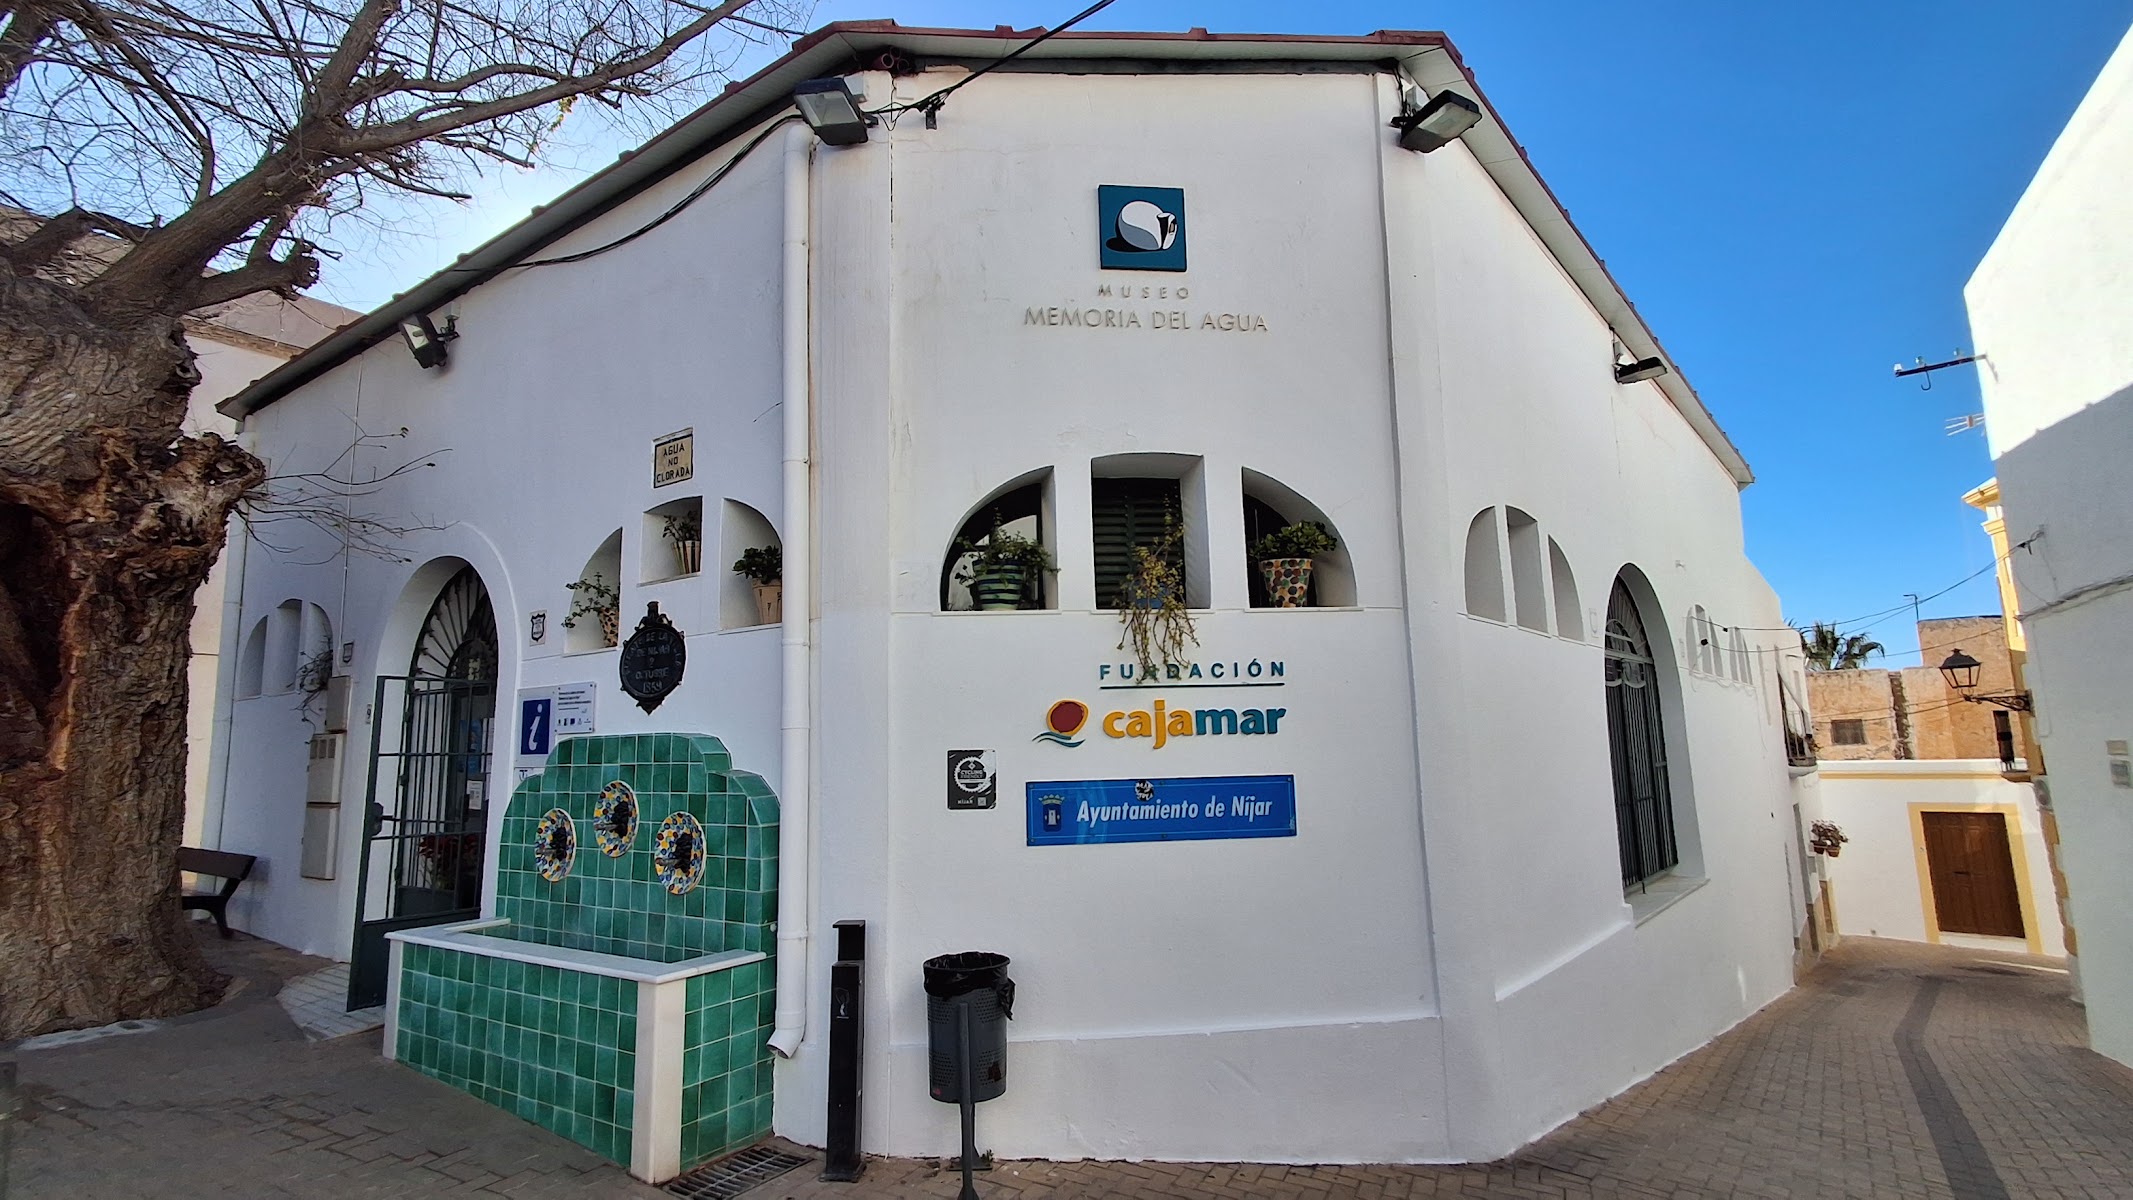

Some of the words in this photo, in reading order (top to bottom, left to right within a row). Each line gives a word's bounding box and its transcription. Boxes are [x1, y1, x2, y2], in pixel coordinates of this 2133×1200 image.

[1098, 284, 1190, 299] MUSEO
[1024, 307, 1142, 329] MEMORIA
[1152, 311, 1191, 330] DEL
[1200, 312, 1269, 332] AGUA
[663, 443, 685, 457] AGUA
[668, 457, 679, 467] NO
[656, 466, 690, 483] CLORADA
[1103, 699, 1287, 749] cajamar
[1076, 800, 1199, 828] Ayuntamiento
[1205, 799, 1225, 818] de
[1231, 796, 1273, 823] Níjar
